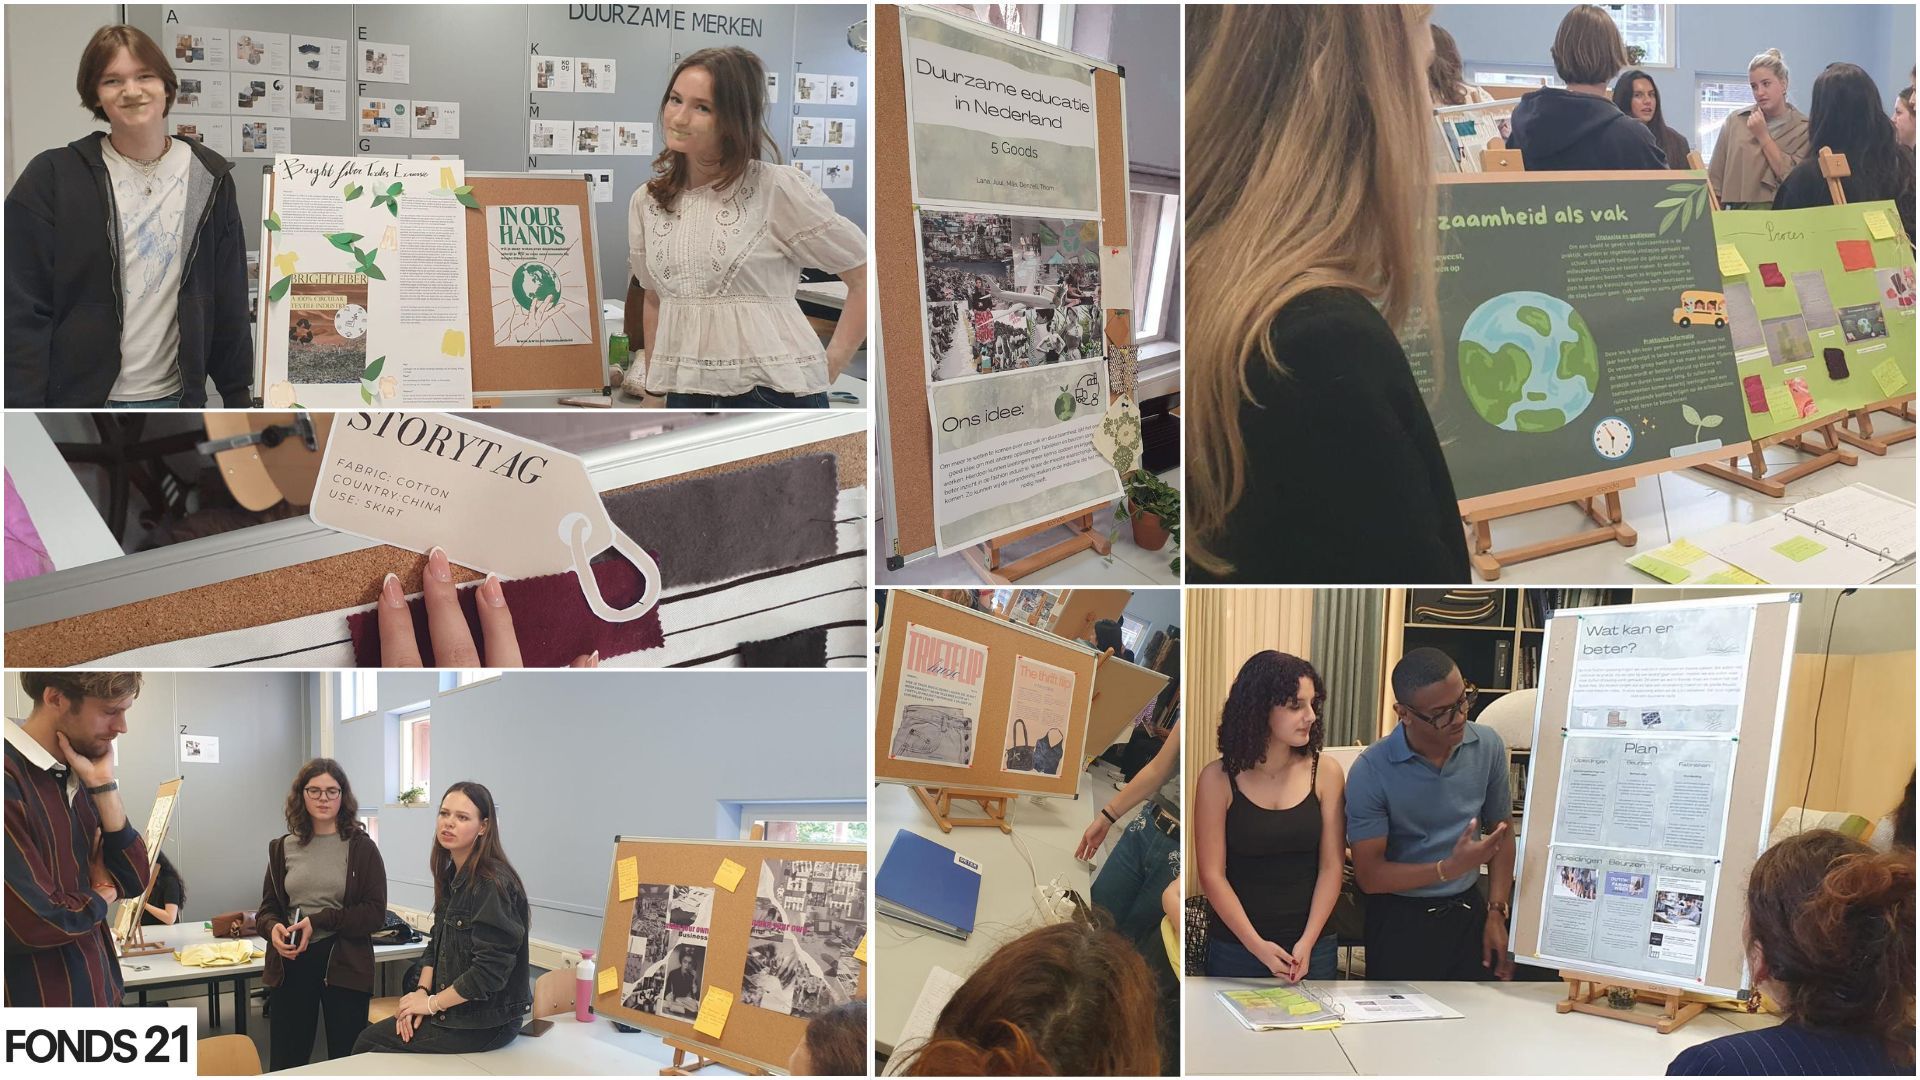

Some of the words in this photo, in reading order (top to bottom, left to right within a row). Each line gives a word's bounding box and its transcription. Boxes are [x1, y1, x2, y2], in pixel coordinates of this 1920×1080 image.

[166, 10, 179, 24] A
[568, 4, 685, 30] DUURZAME
[692, 12, 762, 37] MERKEN
[358, 27, 367, 40] E
[531, 43, 539, 55] K
[359, 84, 367, 96] F
[916, 57, 1017, 96] Duurzame
[1021, 89, 1090, 113] educatie
[530, 93, 536, 104] L
[529, 106, 539, 117] M
[793, 105, 800, 115] U
[955, 95, 970, 111] in
[975, 99, 1062, 128] Nederland
[359, 139, 370, 151] G
[991, 141, 999, 154] 5
[1001, 141, 1038, 158] Goods
[792, 148, 798, 158] V
[529, 156, 537, 168] N
[499, 207, 517, 225] IN
[520, 207, 562, 226] OUR
[1438, 205, 1548, 231] zaamheid
[1554, 205, 1585, 225] als
[1590, 203, 1629, 222] vak
[499, 225, 566, 245] HANDS
[942, 416, 981, 432] Ons
[984, 405, 1024, 423] idee:
[346, 412, 549, 485] STORYTAG
[336, 457, 391, 481] FABRIC:
[396, 476, 450, 498] COTTON
[329, 488, 359, 504] USE:
[364, 499, 404, 518] SKIRT
[1586, 624, 1619, 637] Wat
[1622, 623, 1651, 635] kan
[1655, 623, 1674, 634] er
[1582, 642, 1637, 655] beter?
[180, 725, 187, 735] Z
[1624, 742, 1658, 754] Plan
[1608, 858, 1646, 868] Beurzen
[678, 931, 707, 940] Business
